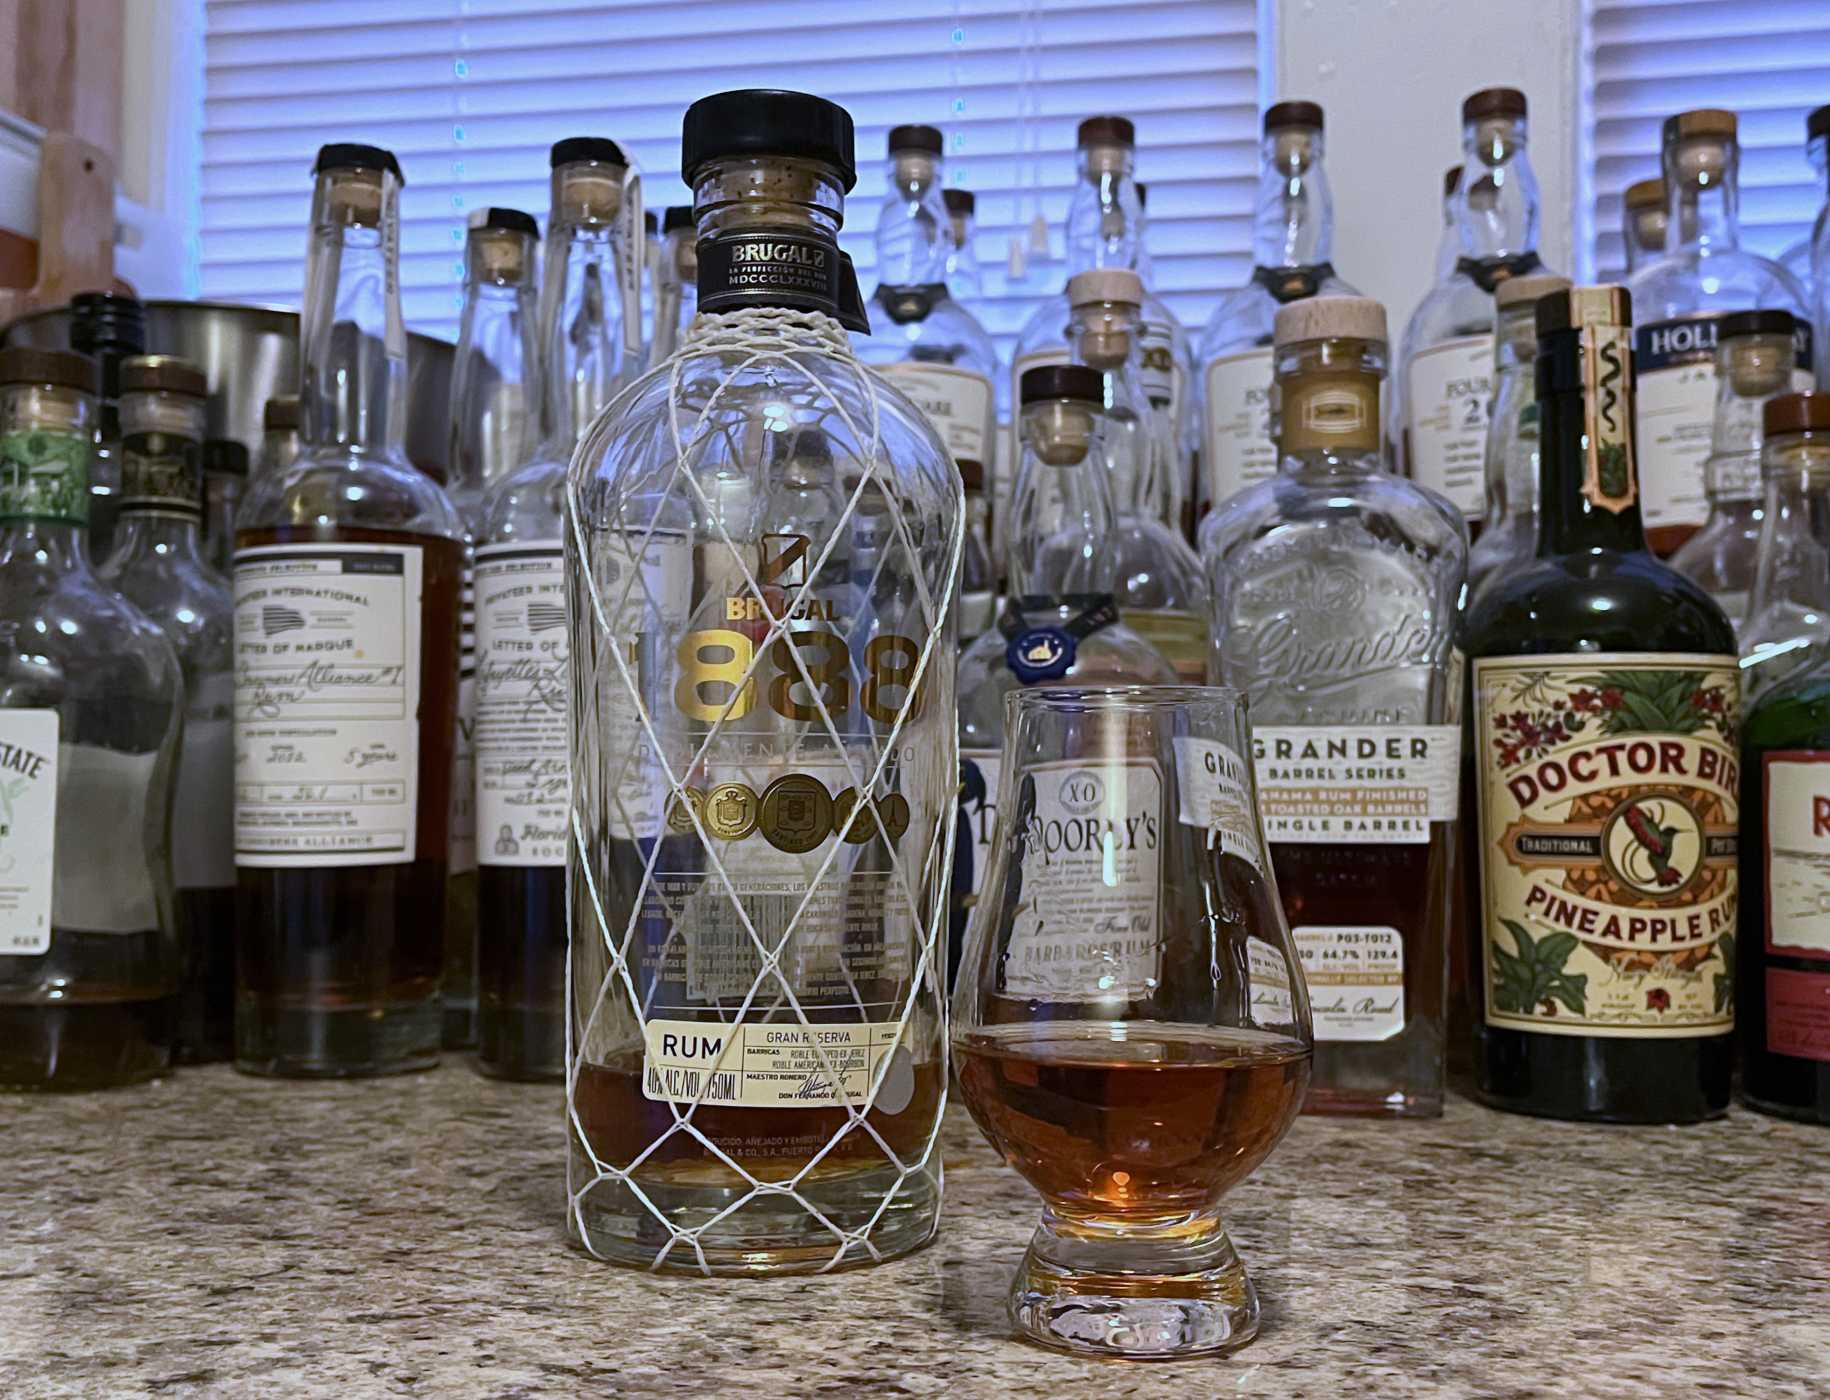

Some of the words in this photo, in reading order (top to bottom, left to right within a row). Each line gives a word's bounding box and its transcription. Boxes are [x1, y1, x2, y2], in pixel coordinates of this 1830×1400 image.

[731, 243, 813, 265] BRUGAL
[1651, 322, 1718, 355] HOL
[1269, 768, 1337, 780] BARREL
[1345, 767, 1407, 780] SERIES
[1507, 741, 1689, 811] DOCTOR
[1697, 746, 1740, 803] BIR
[1267, 820, 1331, 832] INGLE
[1343, 819, 1425, 832] BARREL
[1521, 837, 1592, 853] TRADITIONAL
[766, 1032, 798, 1044] GRAN
[802, 1031, 851, 1044] RSERVA
[662, 1033, 722, 1060] RUM
[747, 1048, 780, 1056] BARRICAS
